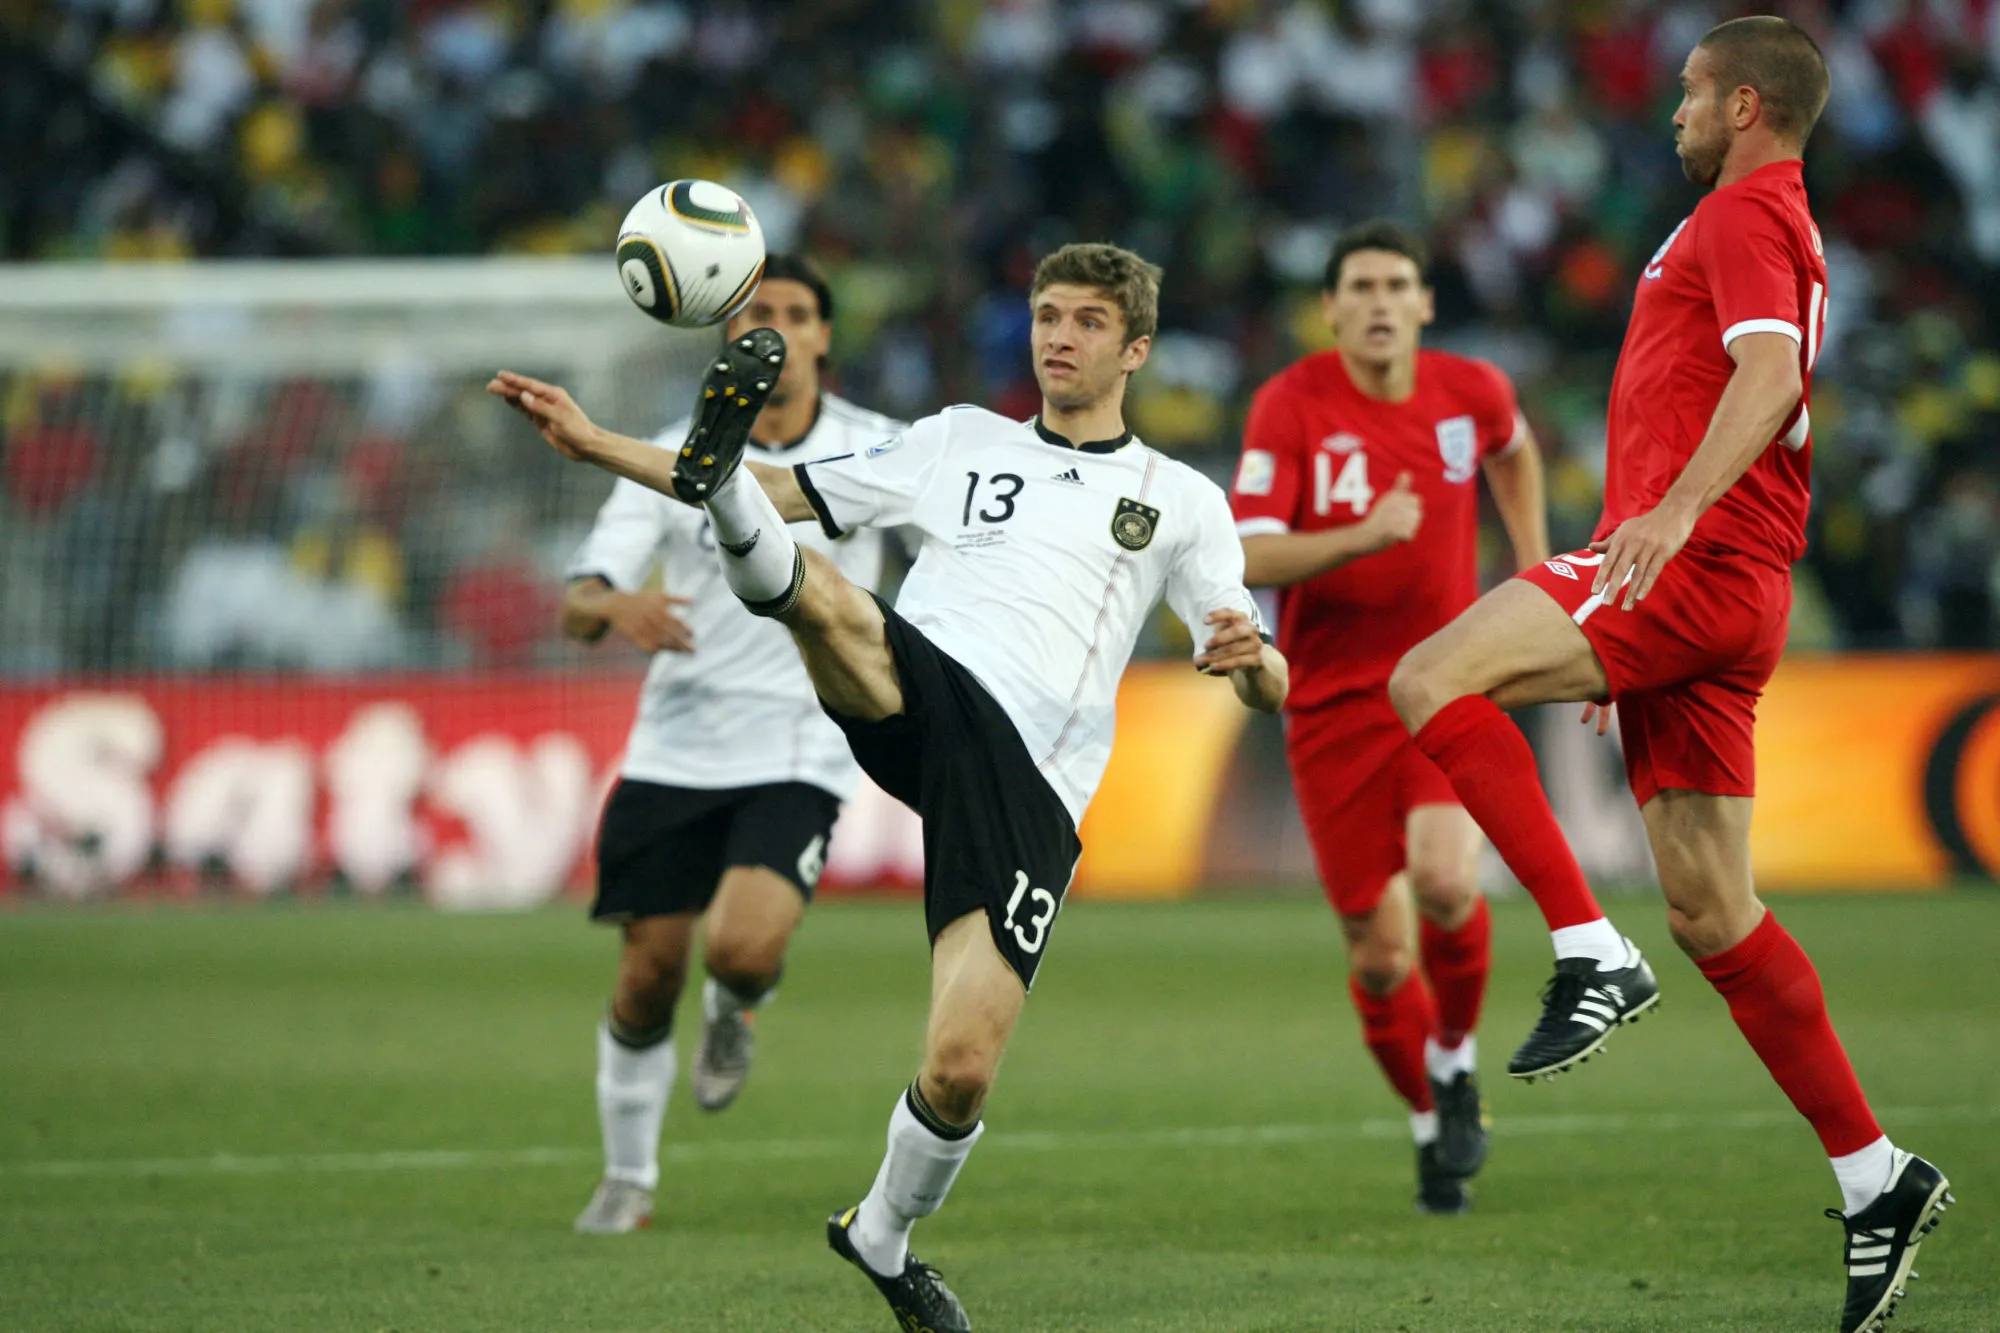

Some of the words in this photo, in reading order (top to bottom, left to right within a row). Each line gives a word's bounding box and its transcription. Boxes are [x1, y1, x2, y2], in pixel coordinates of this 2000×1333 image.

[963, 471, 1025, 527] 13
[1313, 451, 1375, 516] 14
[1003, 869, 1057, 955] 13
